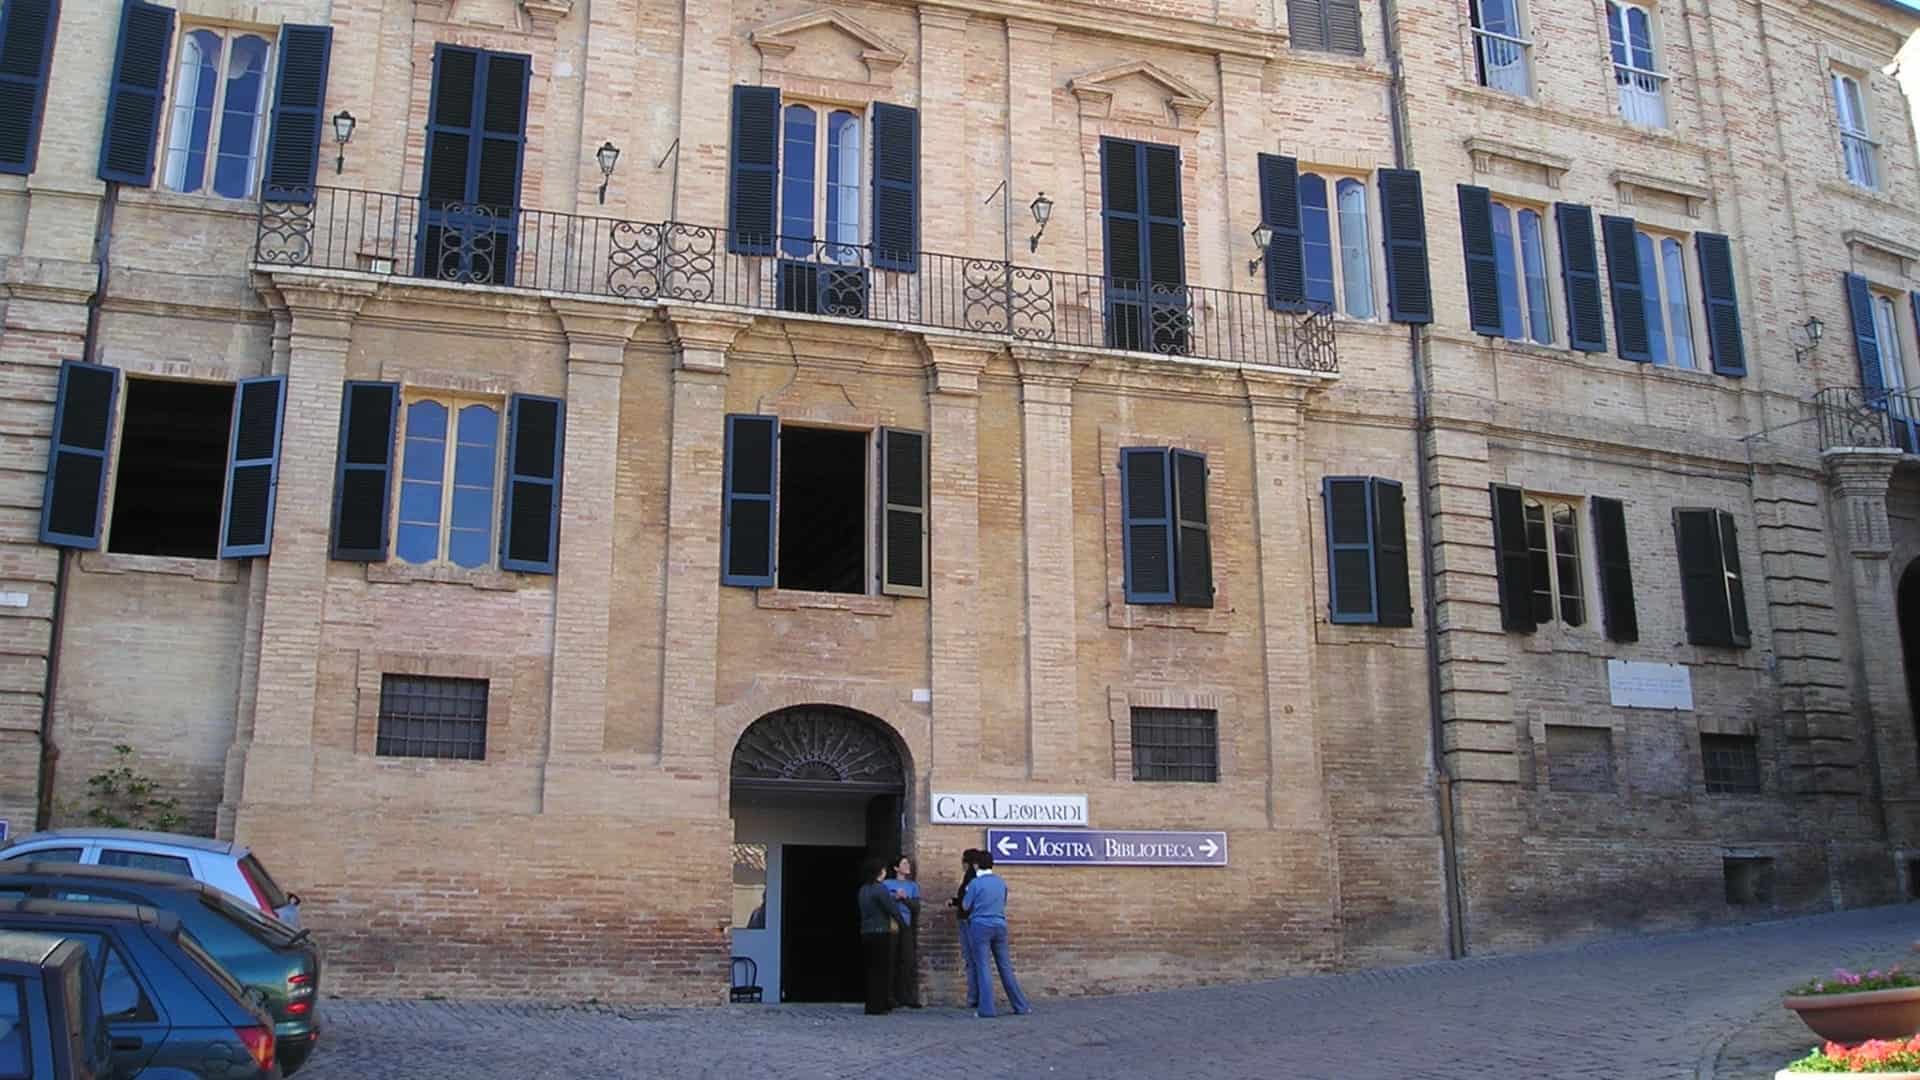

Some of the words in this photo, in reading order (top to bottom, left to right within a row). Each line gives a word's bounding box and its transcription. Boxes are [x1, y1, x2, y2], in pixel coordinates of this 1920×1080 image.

[937, 796, 990, 819] CASA
[992, 798, 1082, 820] LEOPARDI
[1025, 836, 1094, 857] MOSTRA
[1105, 838, 1194, 857] BIBLIOTECA
